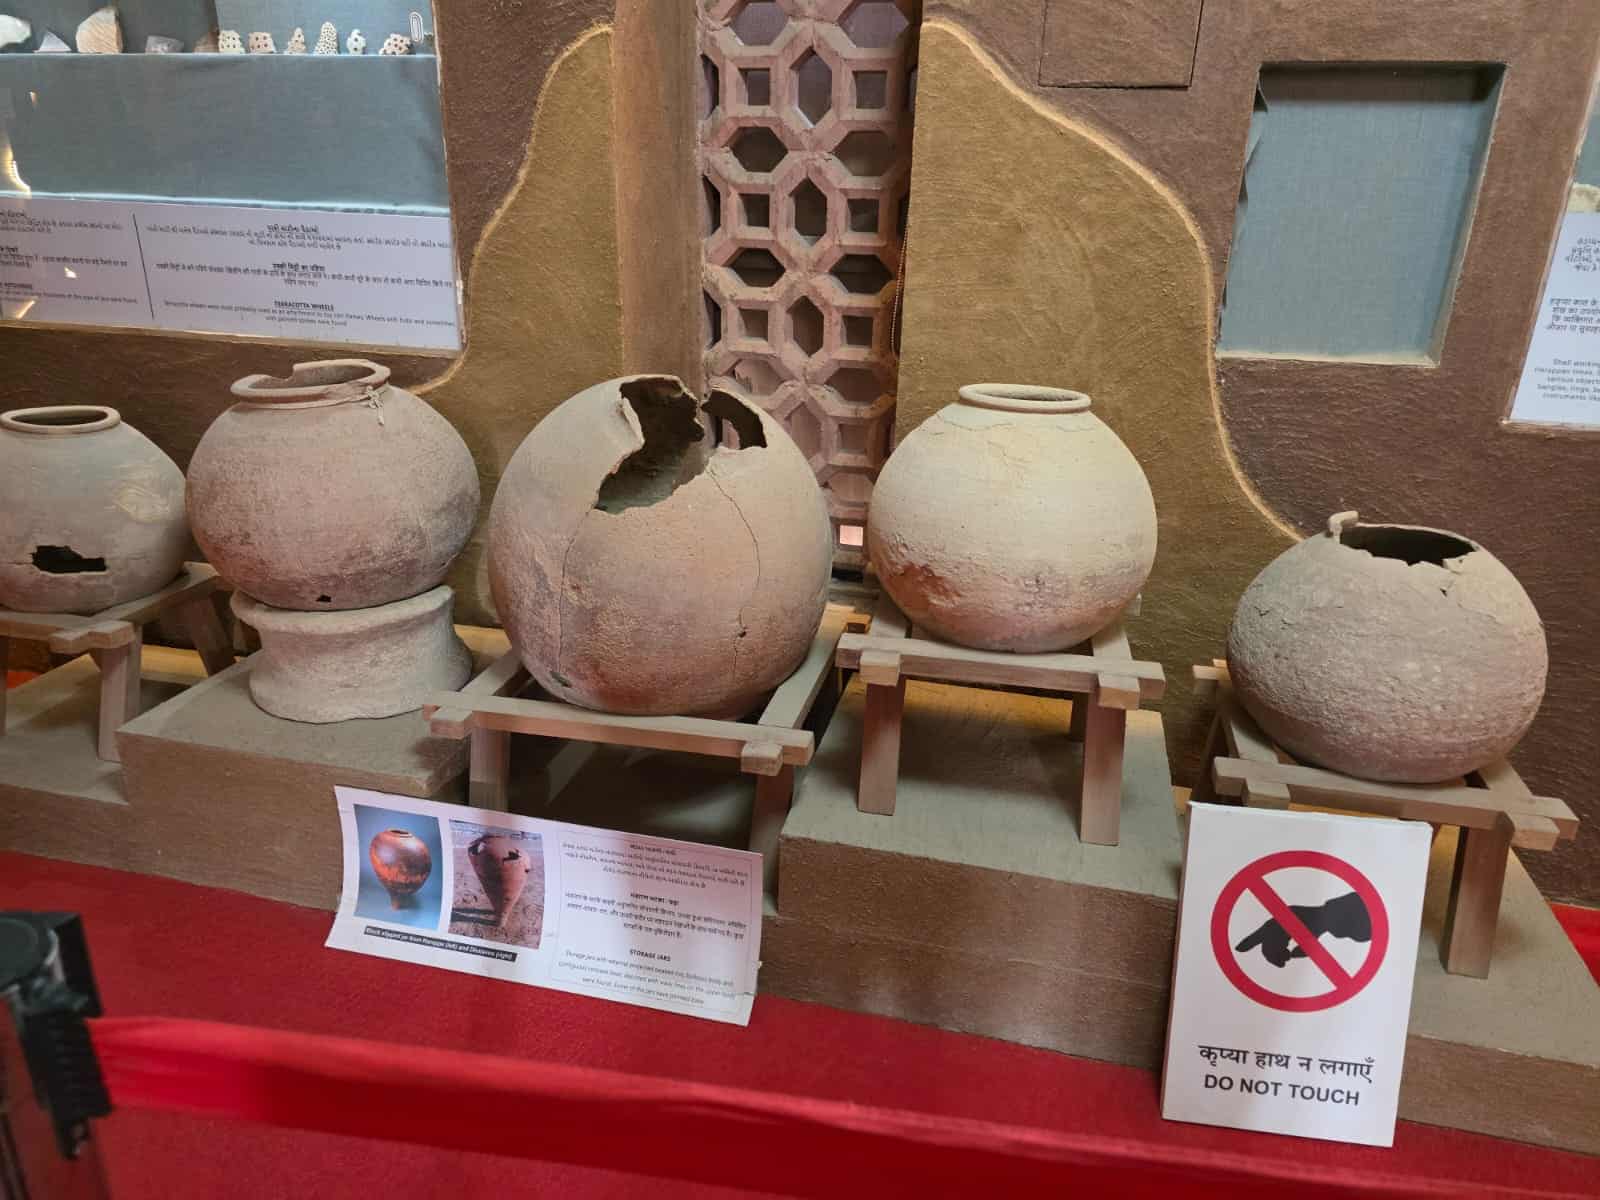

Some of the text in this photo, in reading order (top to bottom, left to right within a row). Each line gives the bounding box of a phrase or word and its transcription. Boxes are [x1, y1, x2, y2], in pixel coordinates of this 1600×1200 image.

[629, 948, 671, 962] STORAGE JARS
[1198, 1045, 1375, 1084] कृप्या हाथ न लगाएँ
[1204, 1074, 1360, 1106] DO NOT TOUCH
